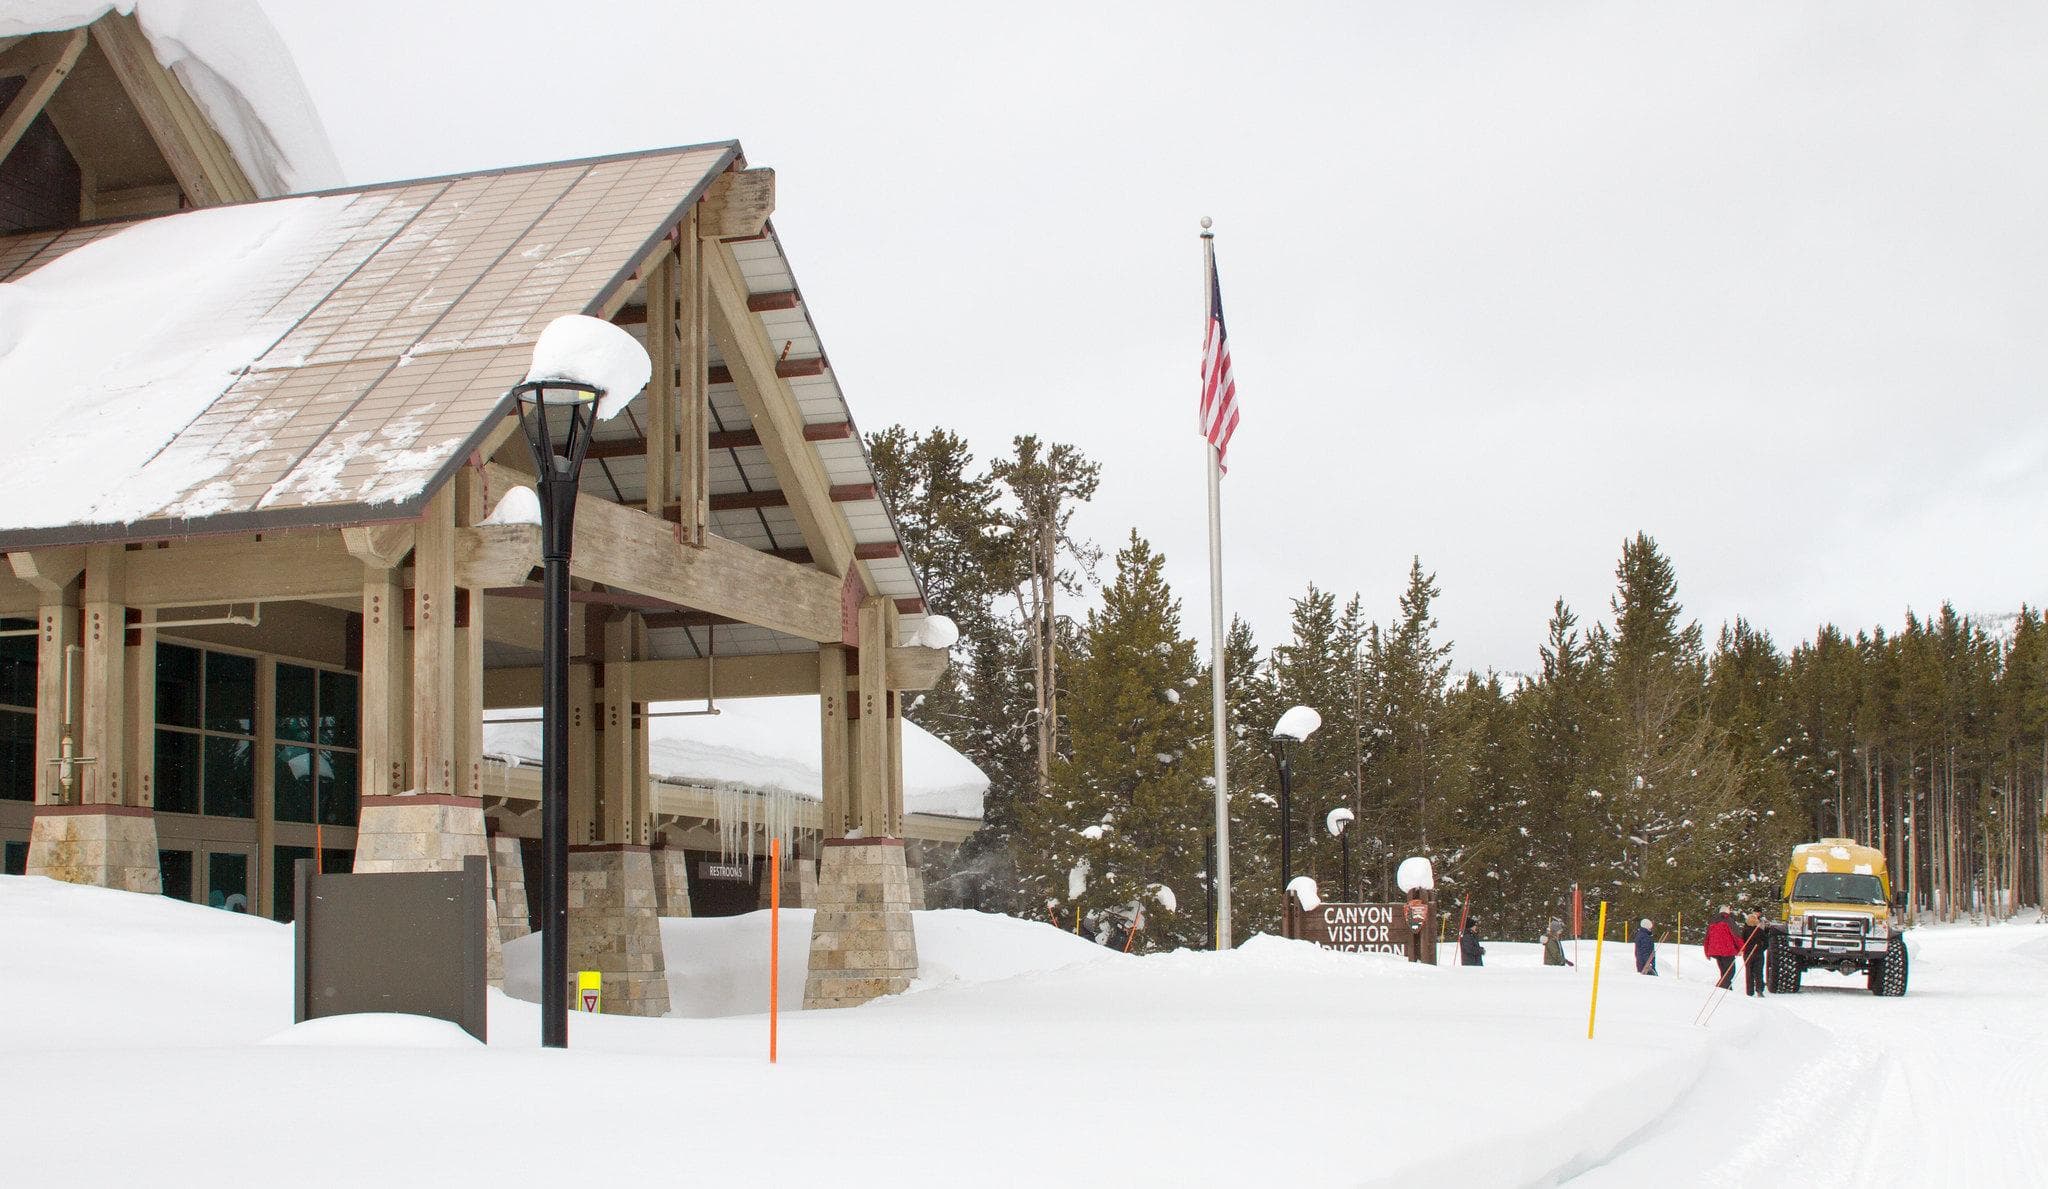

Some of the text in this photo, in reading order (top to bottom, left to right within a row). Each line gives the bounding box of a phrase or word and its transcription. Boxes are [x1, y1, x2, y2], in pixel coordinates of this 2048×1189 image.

[709, 866, 743, 877] RESTROOMS
[1324, 907, 1393, 924] CANYON
[1328, 925, 1389, 942] VISITOR
[1321, 943, 1405, 956] ATION
